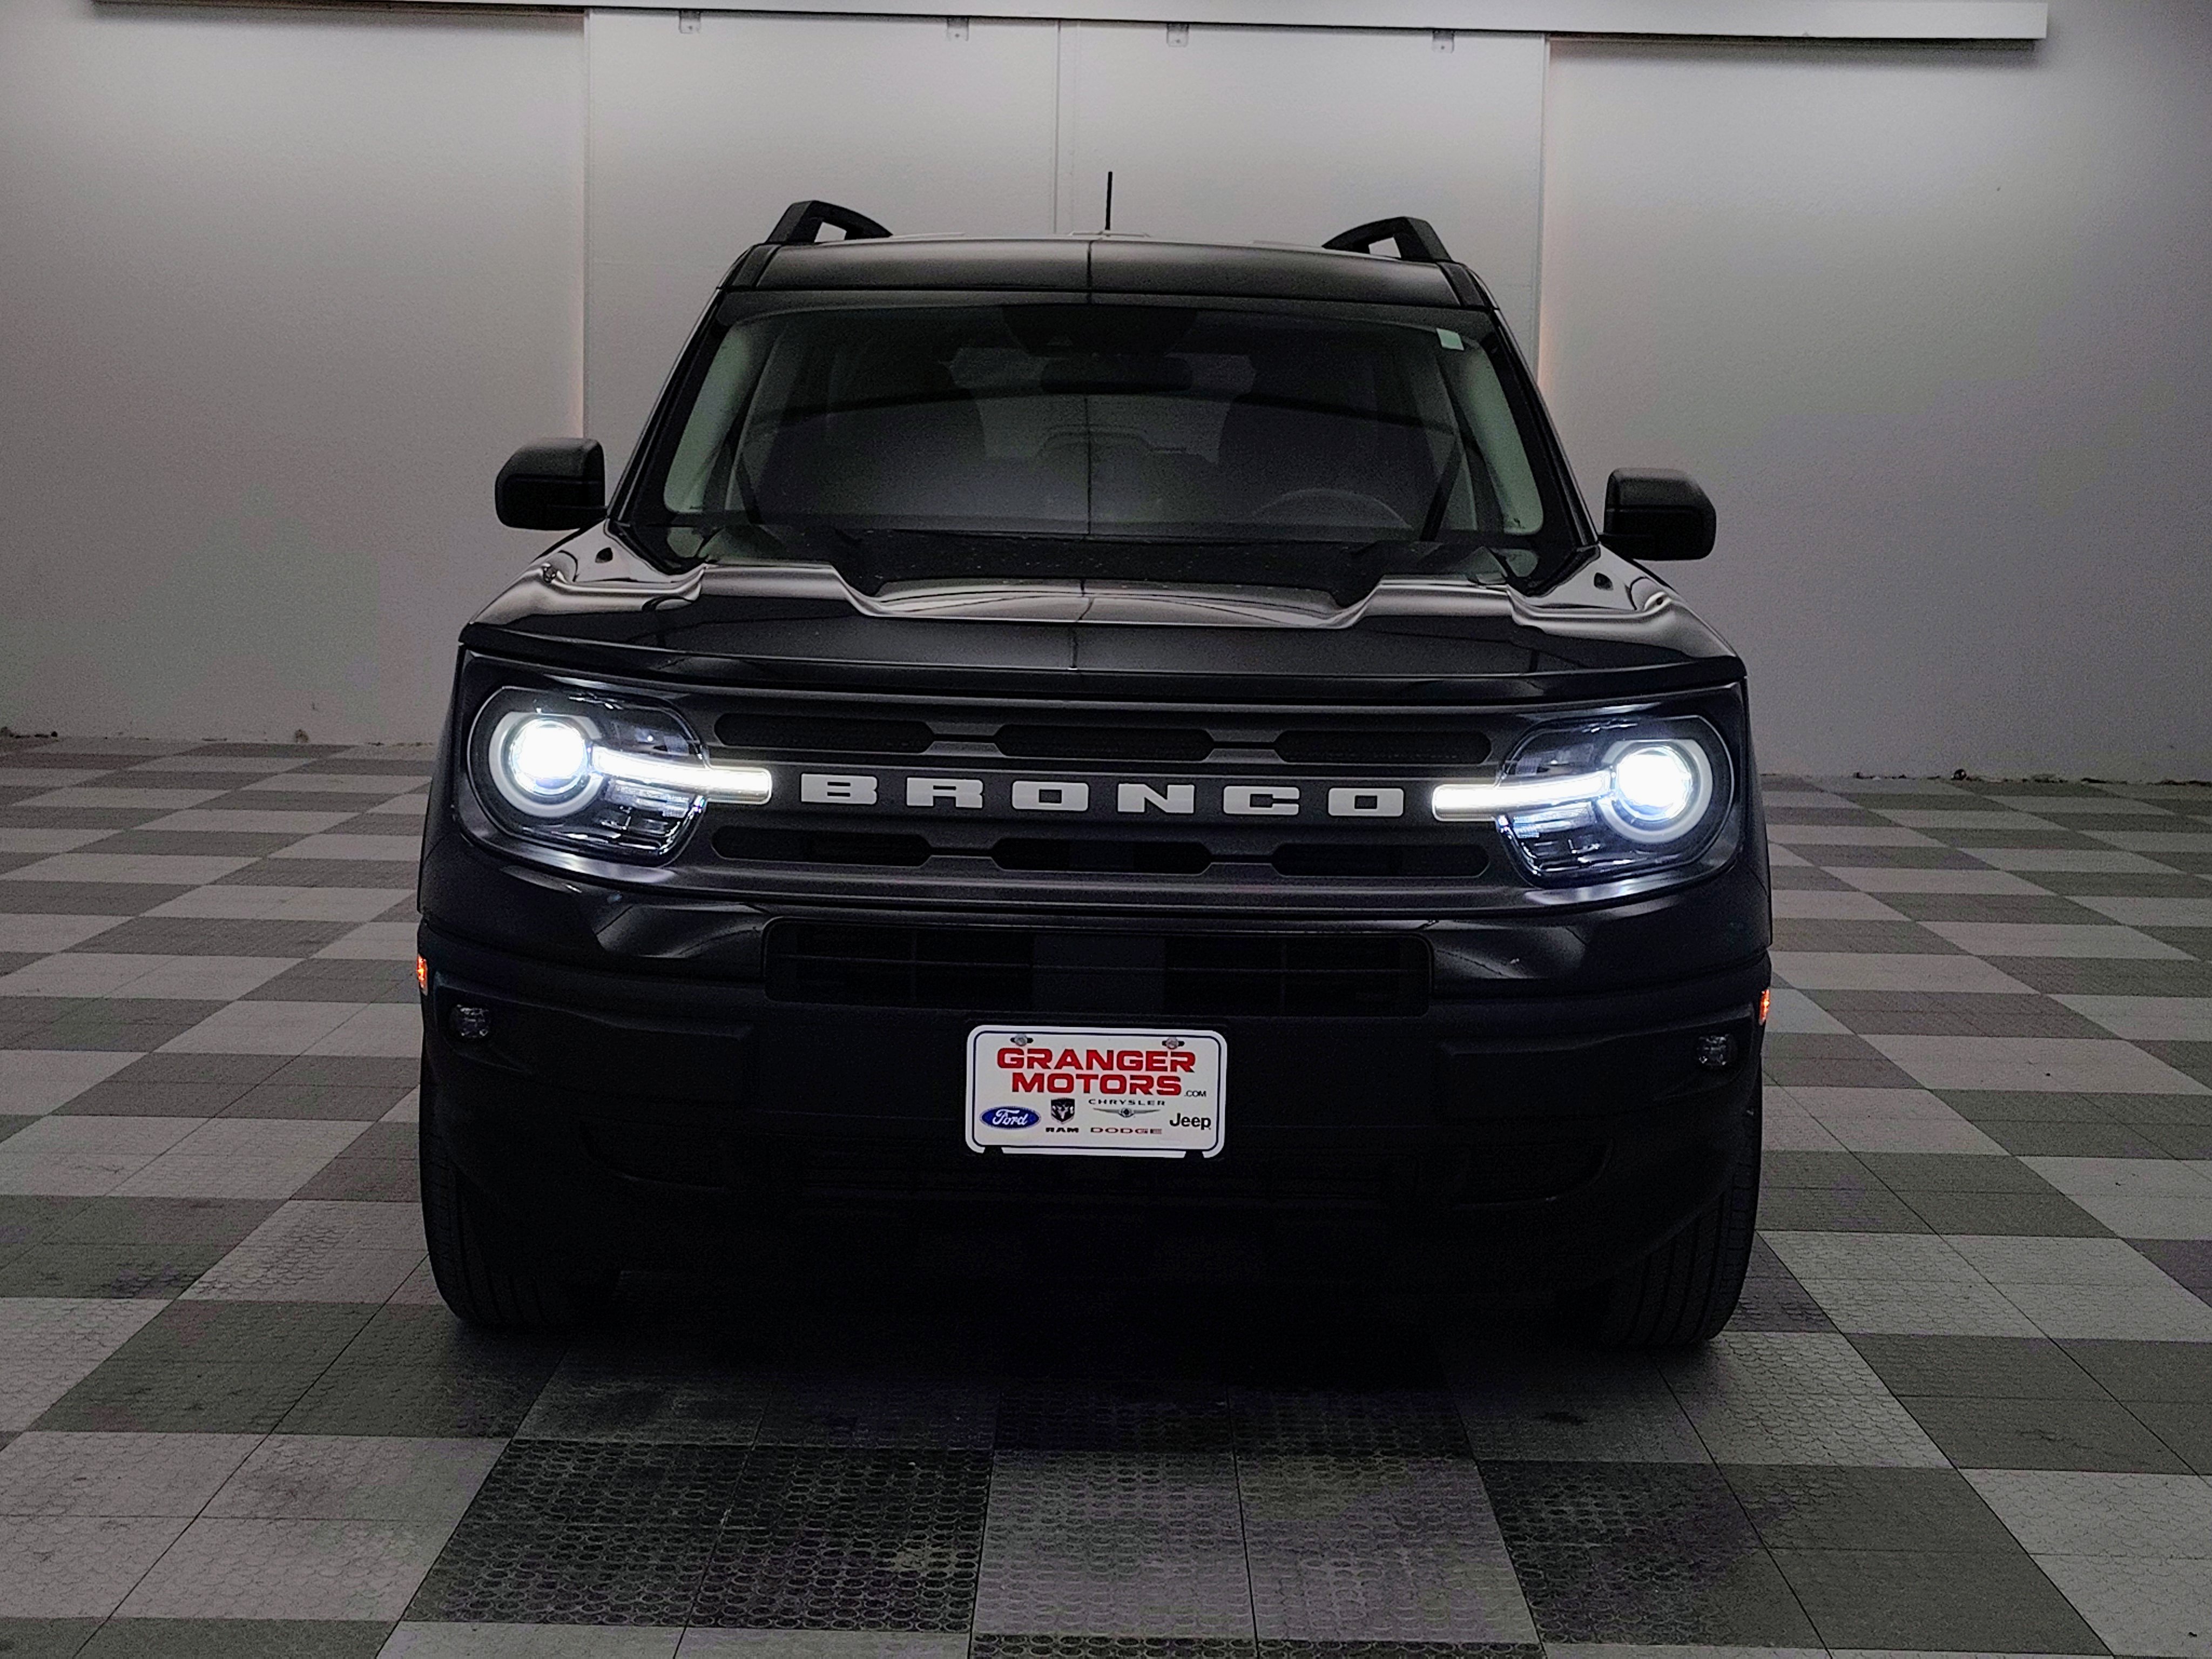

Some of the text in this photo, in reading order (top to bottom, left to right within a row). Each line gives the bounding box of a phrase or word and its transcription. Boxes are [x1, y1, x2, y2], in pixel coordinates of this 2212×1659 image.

[801, 773, 1404, 817] BRONCO
[997, 1048, 1195, 1073] GRANGER
[1012, 1073, 1182, 1095] MOTORS
[992, 1109, 1028, 1126] Ford
[1169, 1113, 1211, 1130] Jeep
